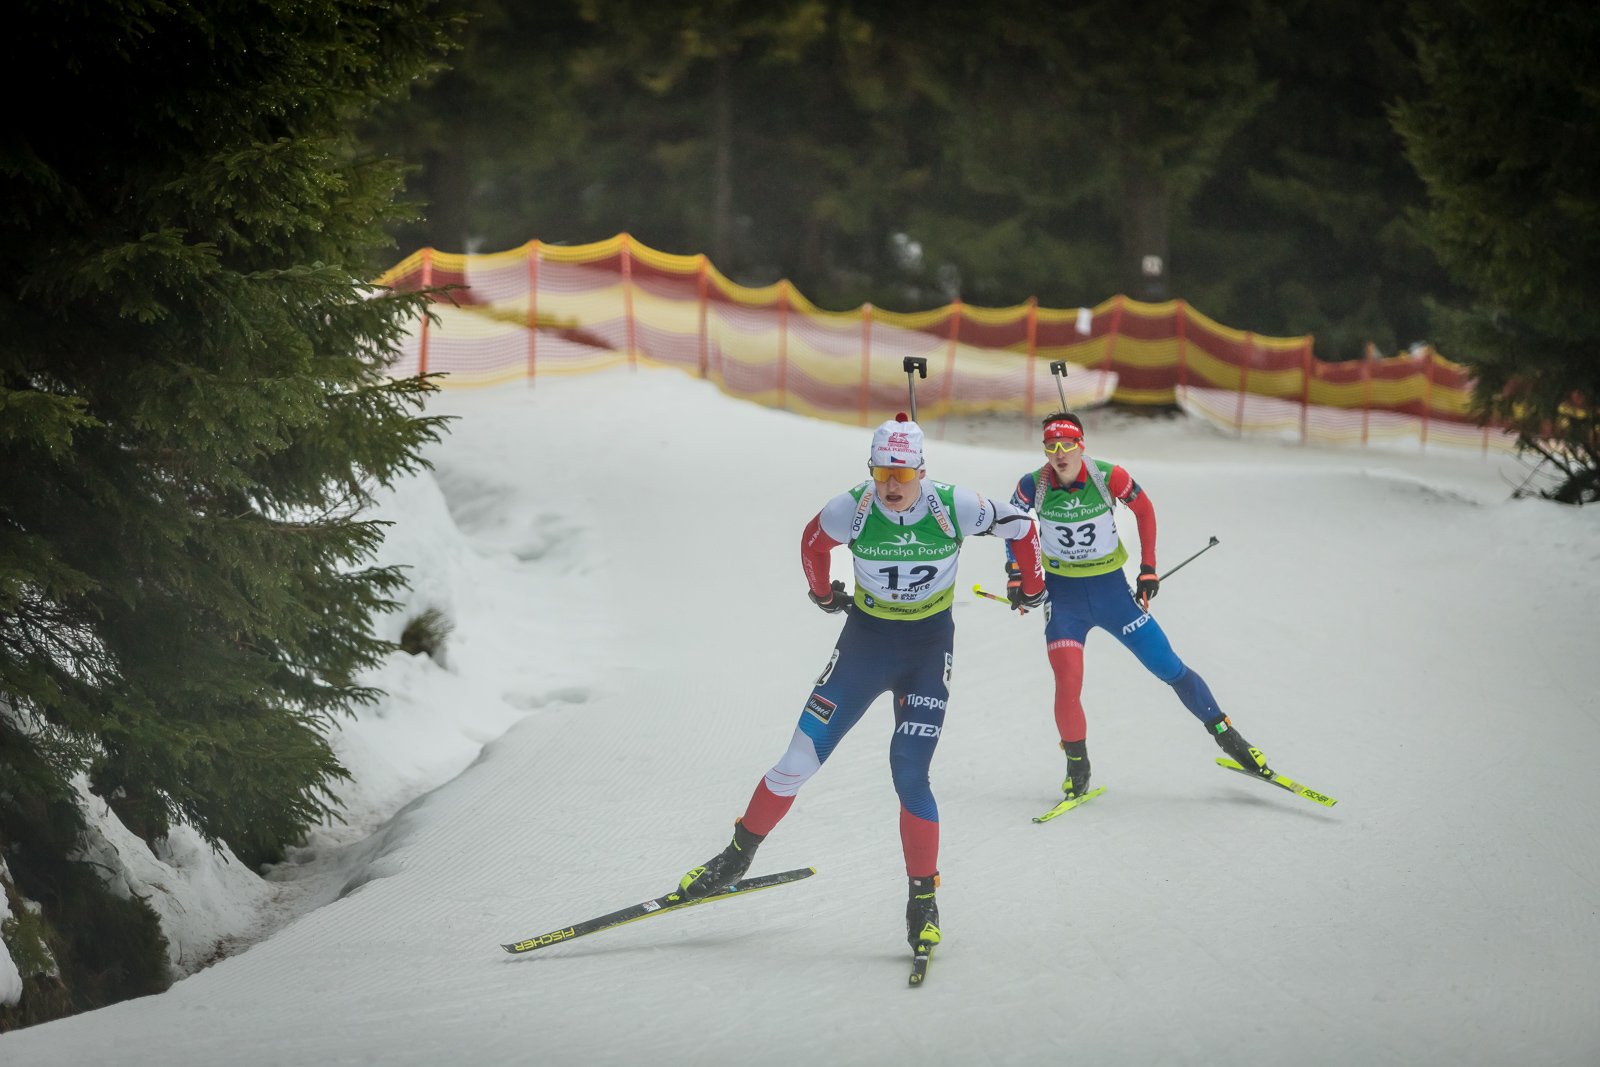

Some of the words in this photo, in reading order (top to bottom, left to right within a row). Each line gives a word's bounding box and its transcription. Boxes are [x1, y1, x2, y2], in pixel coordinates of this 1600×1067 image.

[853, 492, 873, 531] OCUTEIN
[927, 494, 951, 533] OCUTEIN
[1055, 523, 1096, 548] 33
[856, 544, 914, 557] Szklarska
[879, 565, 938, 590] 12
[1122, 613, 1151, 635] ATEX
[896, 721, 942, 738] ATEX
[514, 926, 576, 952] FISCHER
